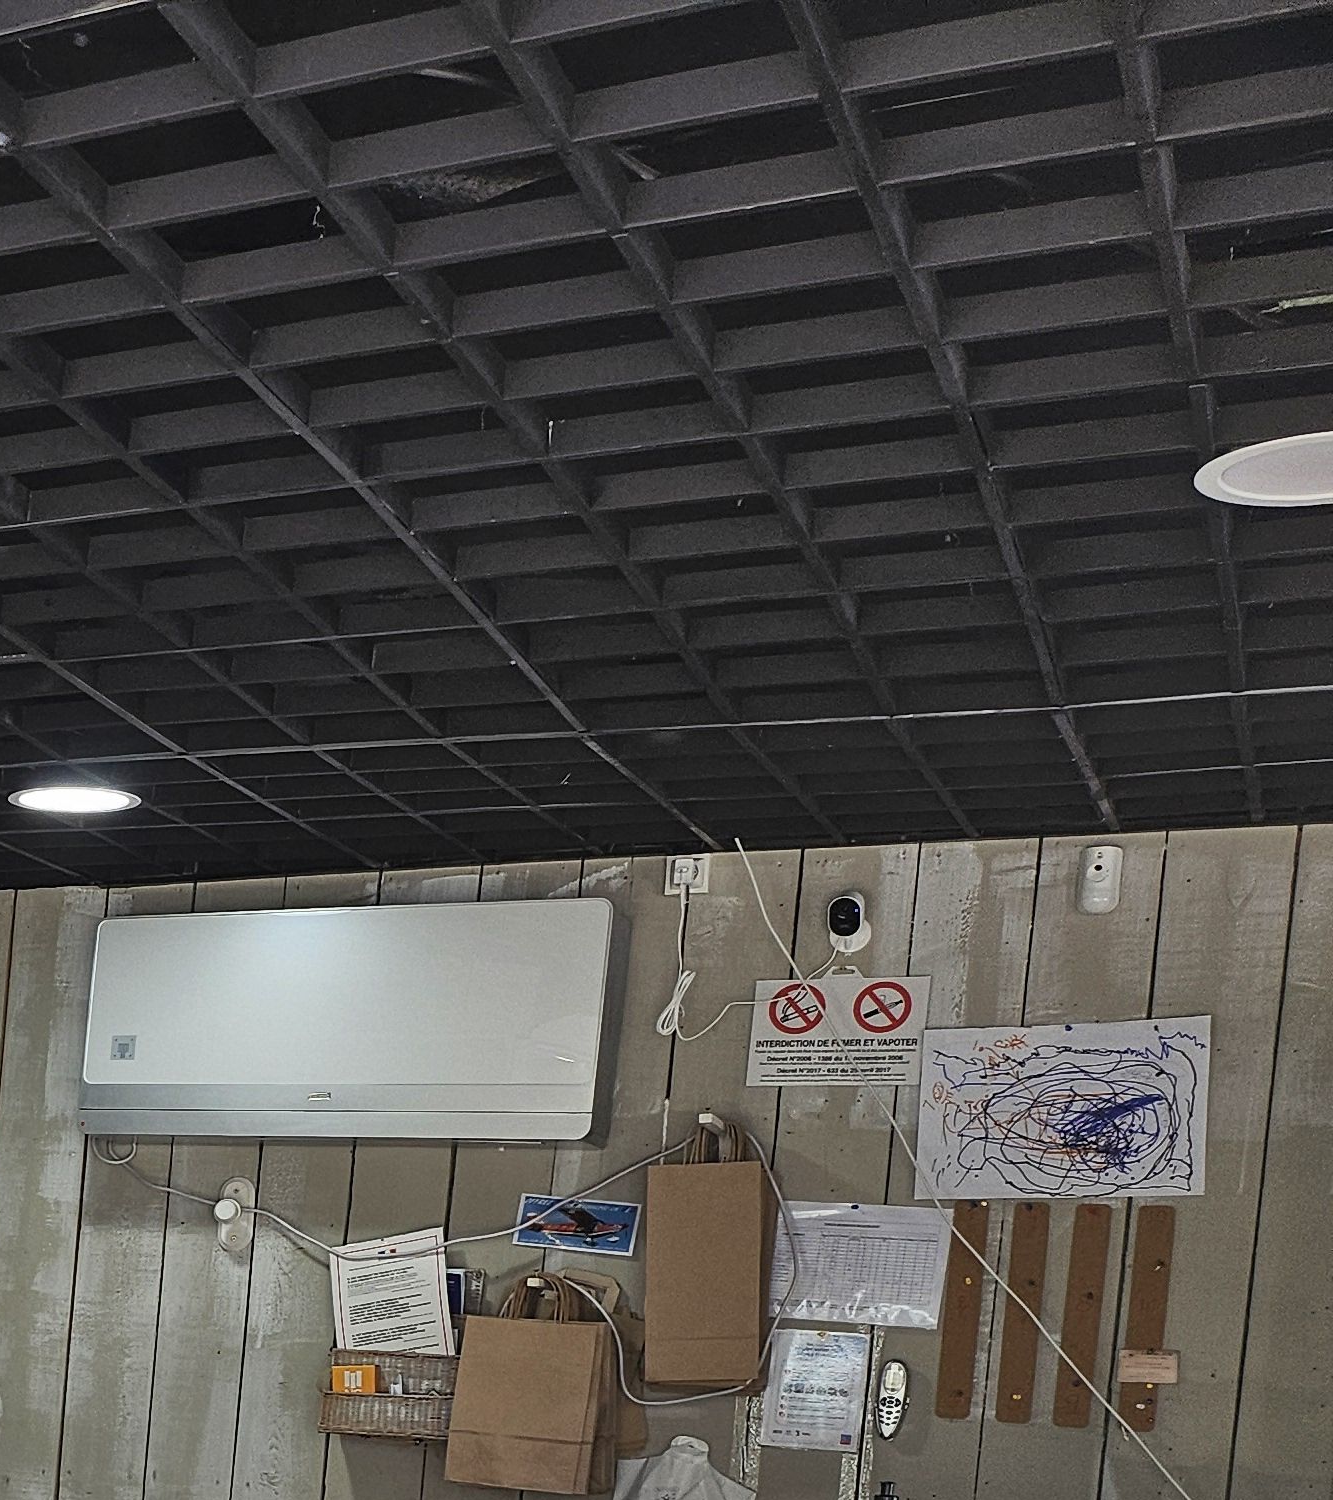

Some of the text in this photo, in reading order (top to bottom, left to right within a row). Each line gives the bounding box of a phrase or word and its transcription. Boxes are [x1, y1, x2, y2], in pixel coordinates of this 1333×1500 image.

[755, 1039, 815, 1049] INTERDICTION
[817, 1038, 829, 1048] DE
[863, 1038, 874, 1047] ET
[876, 1038, 918, 1047] VAPOTER
